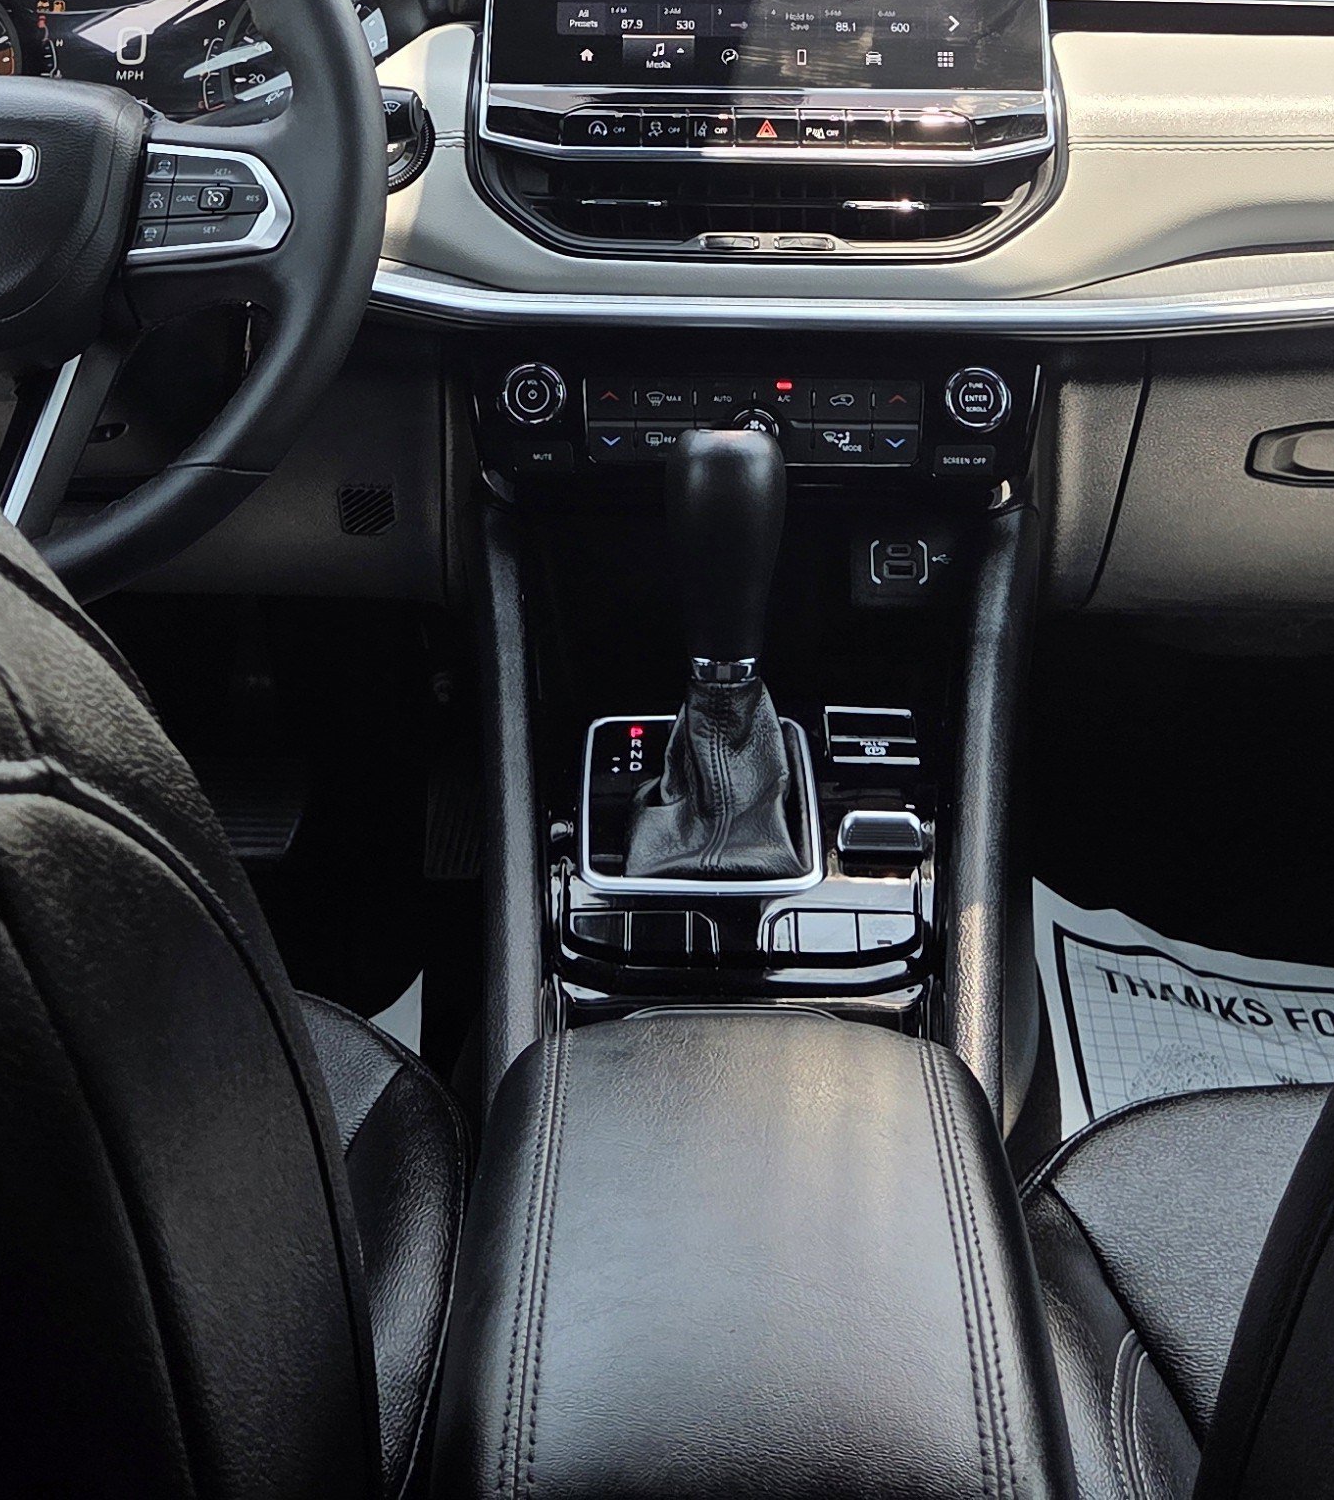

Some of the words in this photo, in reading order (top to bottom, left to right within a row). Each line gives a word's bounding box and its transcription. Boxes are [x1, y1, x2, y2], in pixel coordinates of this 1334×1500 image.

[785, 12, 805, 21] Hold
[806, 13, 814, 21] to
[217, 19, 226, 30] P
[569, 19, 599, 28] Presets
[620, 19, 644, 30] 87.9
[675, 20, 695, 30] 530
[790, 22, 810, 31] Save
[890, 22, 910, 33] 600
[117, 26, 147, 66] 0
[646, 60, 672, 69] Media
[115, 70, 145, 81] MPH
[247, 73, 266, 84] 20
[175, 195, 196, 203] CANC
[245, 194, 260, 202] RES
[713, 395, 732, 403] AUTO
[777, 395, 791, 403] A/C
[964, 394, 988, 403] ENTER
[842, 444, 863, 453] MODE
[533, 453, 552, 461] MUTE
[942, 457, 970, 465] SCREEN
[972, 457, 987, 465] OFF
[630, 726, 644, 738] P
[631, 738, 642, 748] R
[630, 749, 643, 760] N
[629, 761, 643, 772] D
[1096, 965, 1274, 1028] THANKS
